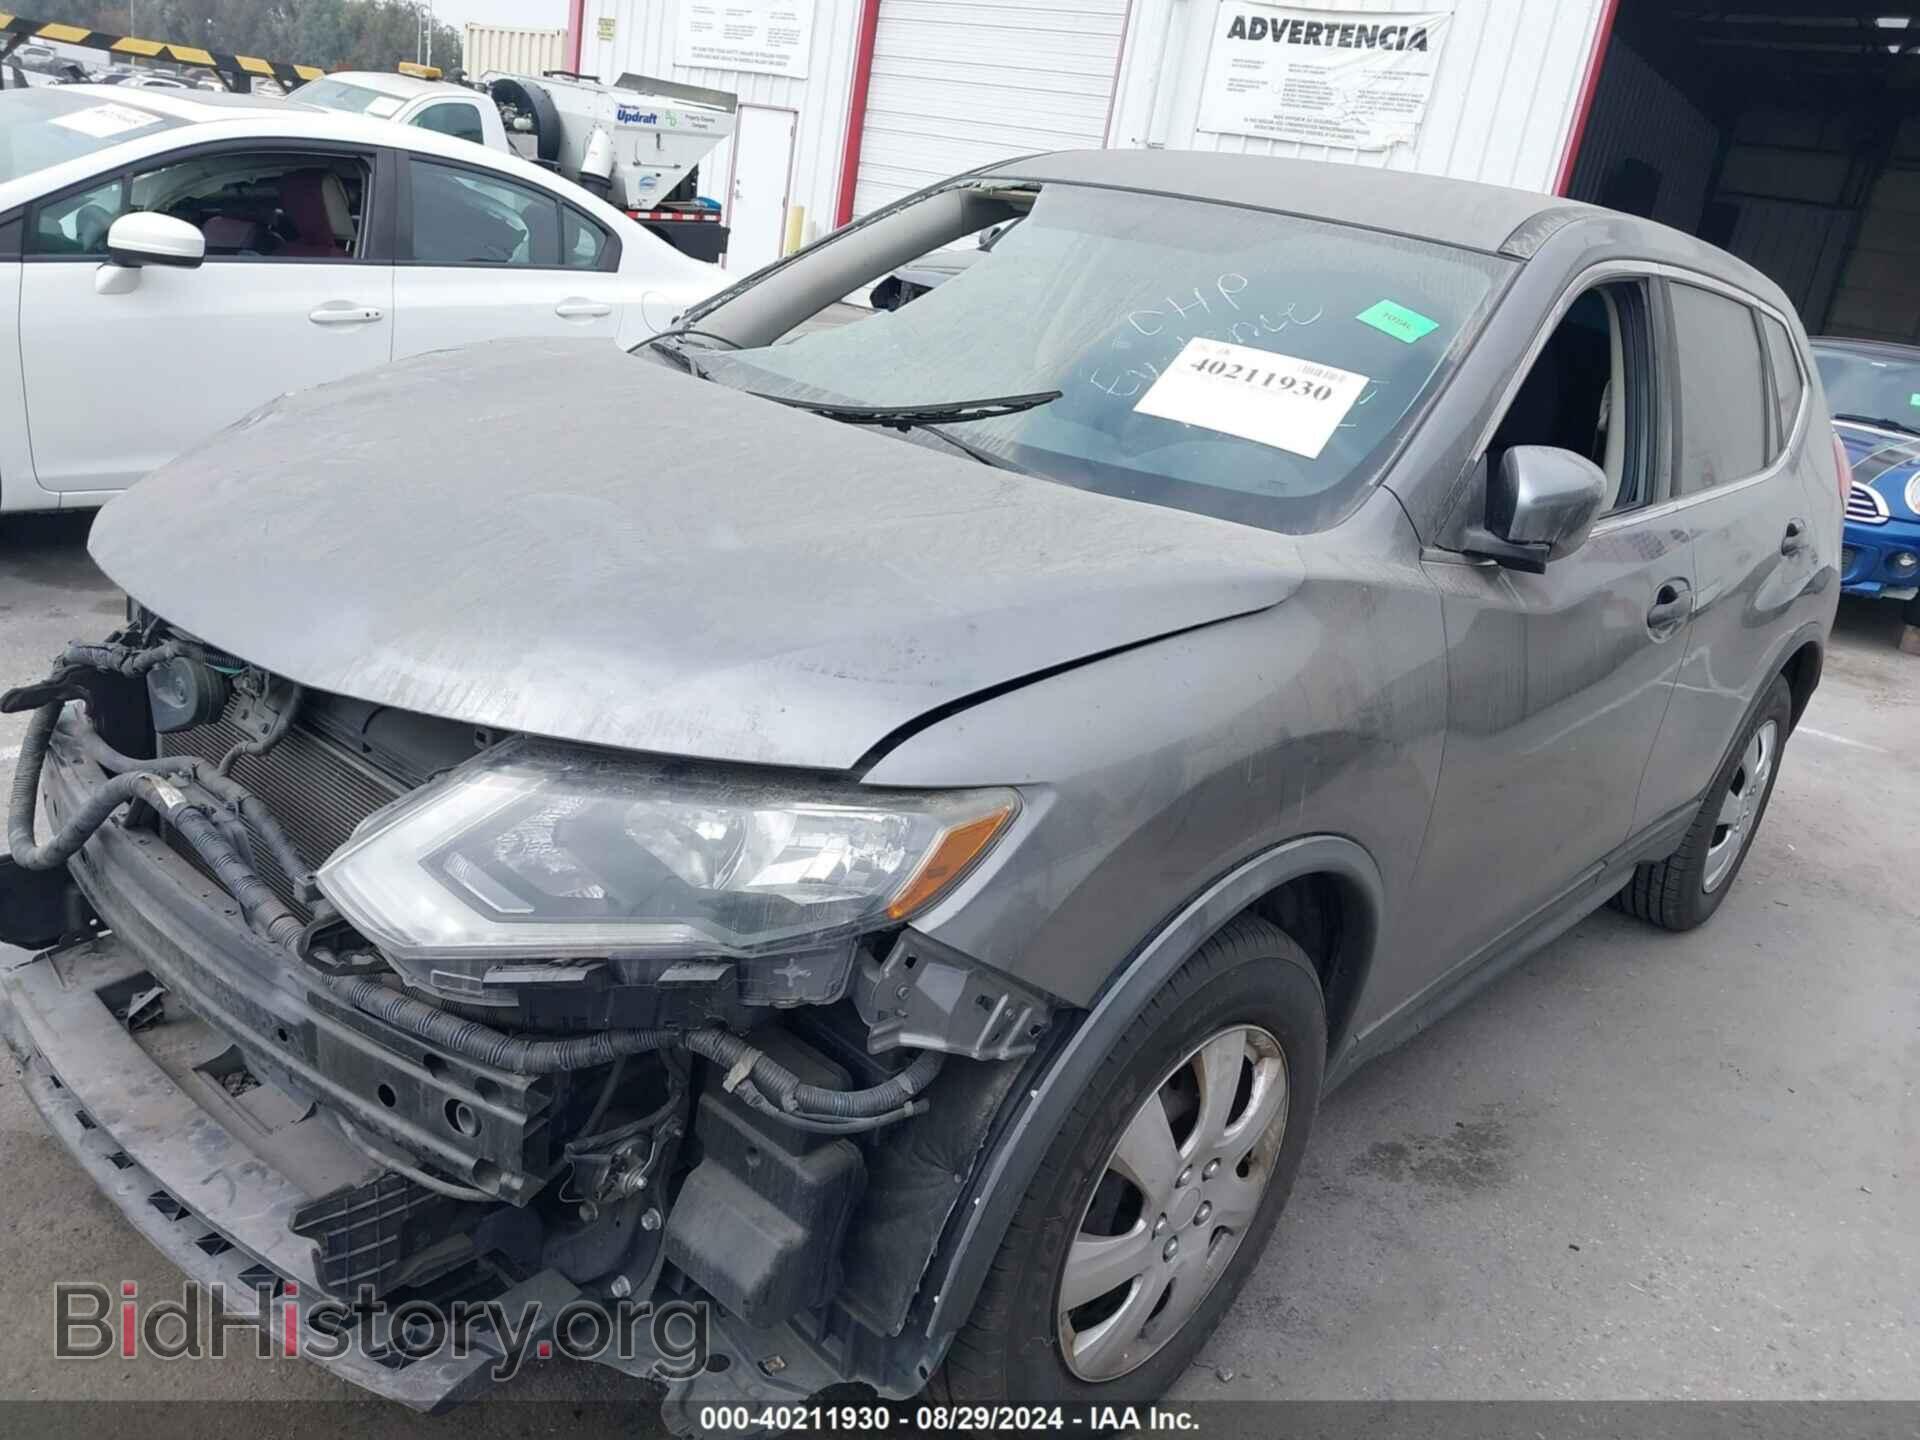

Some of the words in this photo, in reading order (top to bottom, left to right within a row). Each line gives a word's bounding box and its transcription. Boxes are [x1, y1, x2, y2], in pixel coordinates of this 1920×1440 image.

[1227, 15, 1428, 52] ADVERTENCIA
[617, 109, 658, 125] Updraft
[1128, 273, 1249, 336] CHP
[1190, 358, 1332, 401] 40211930
